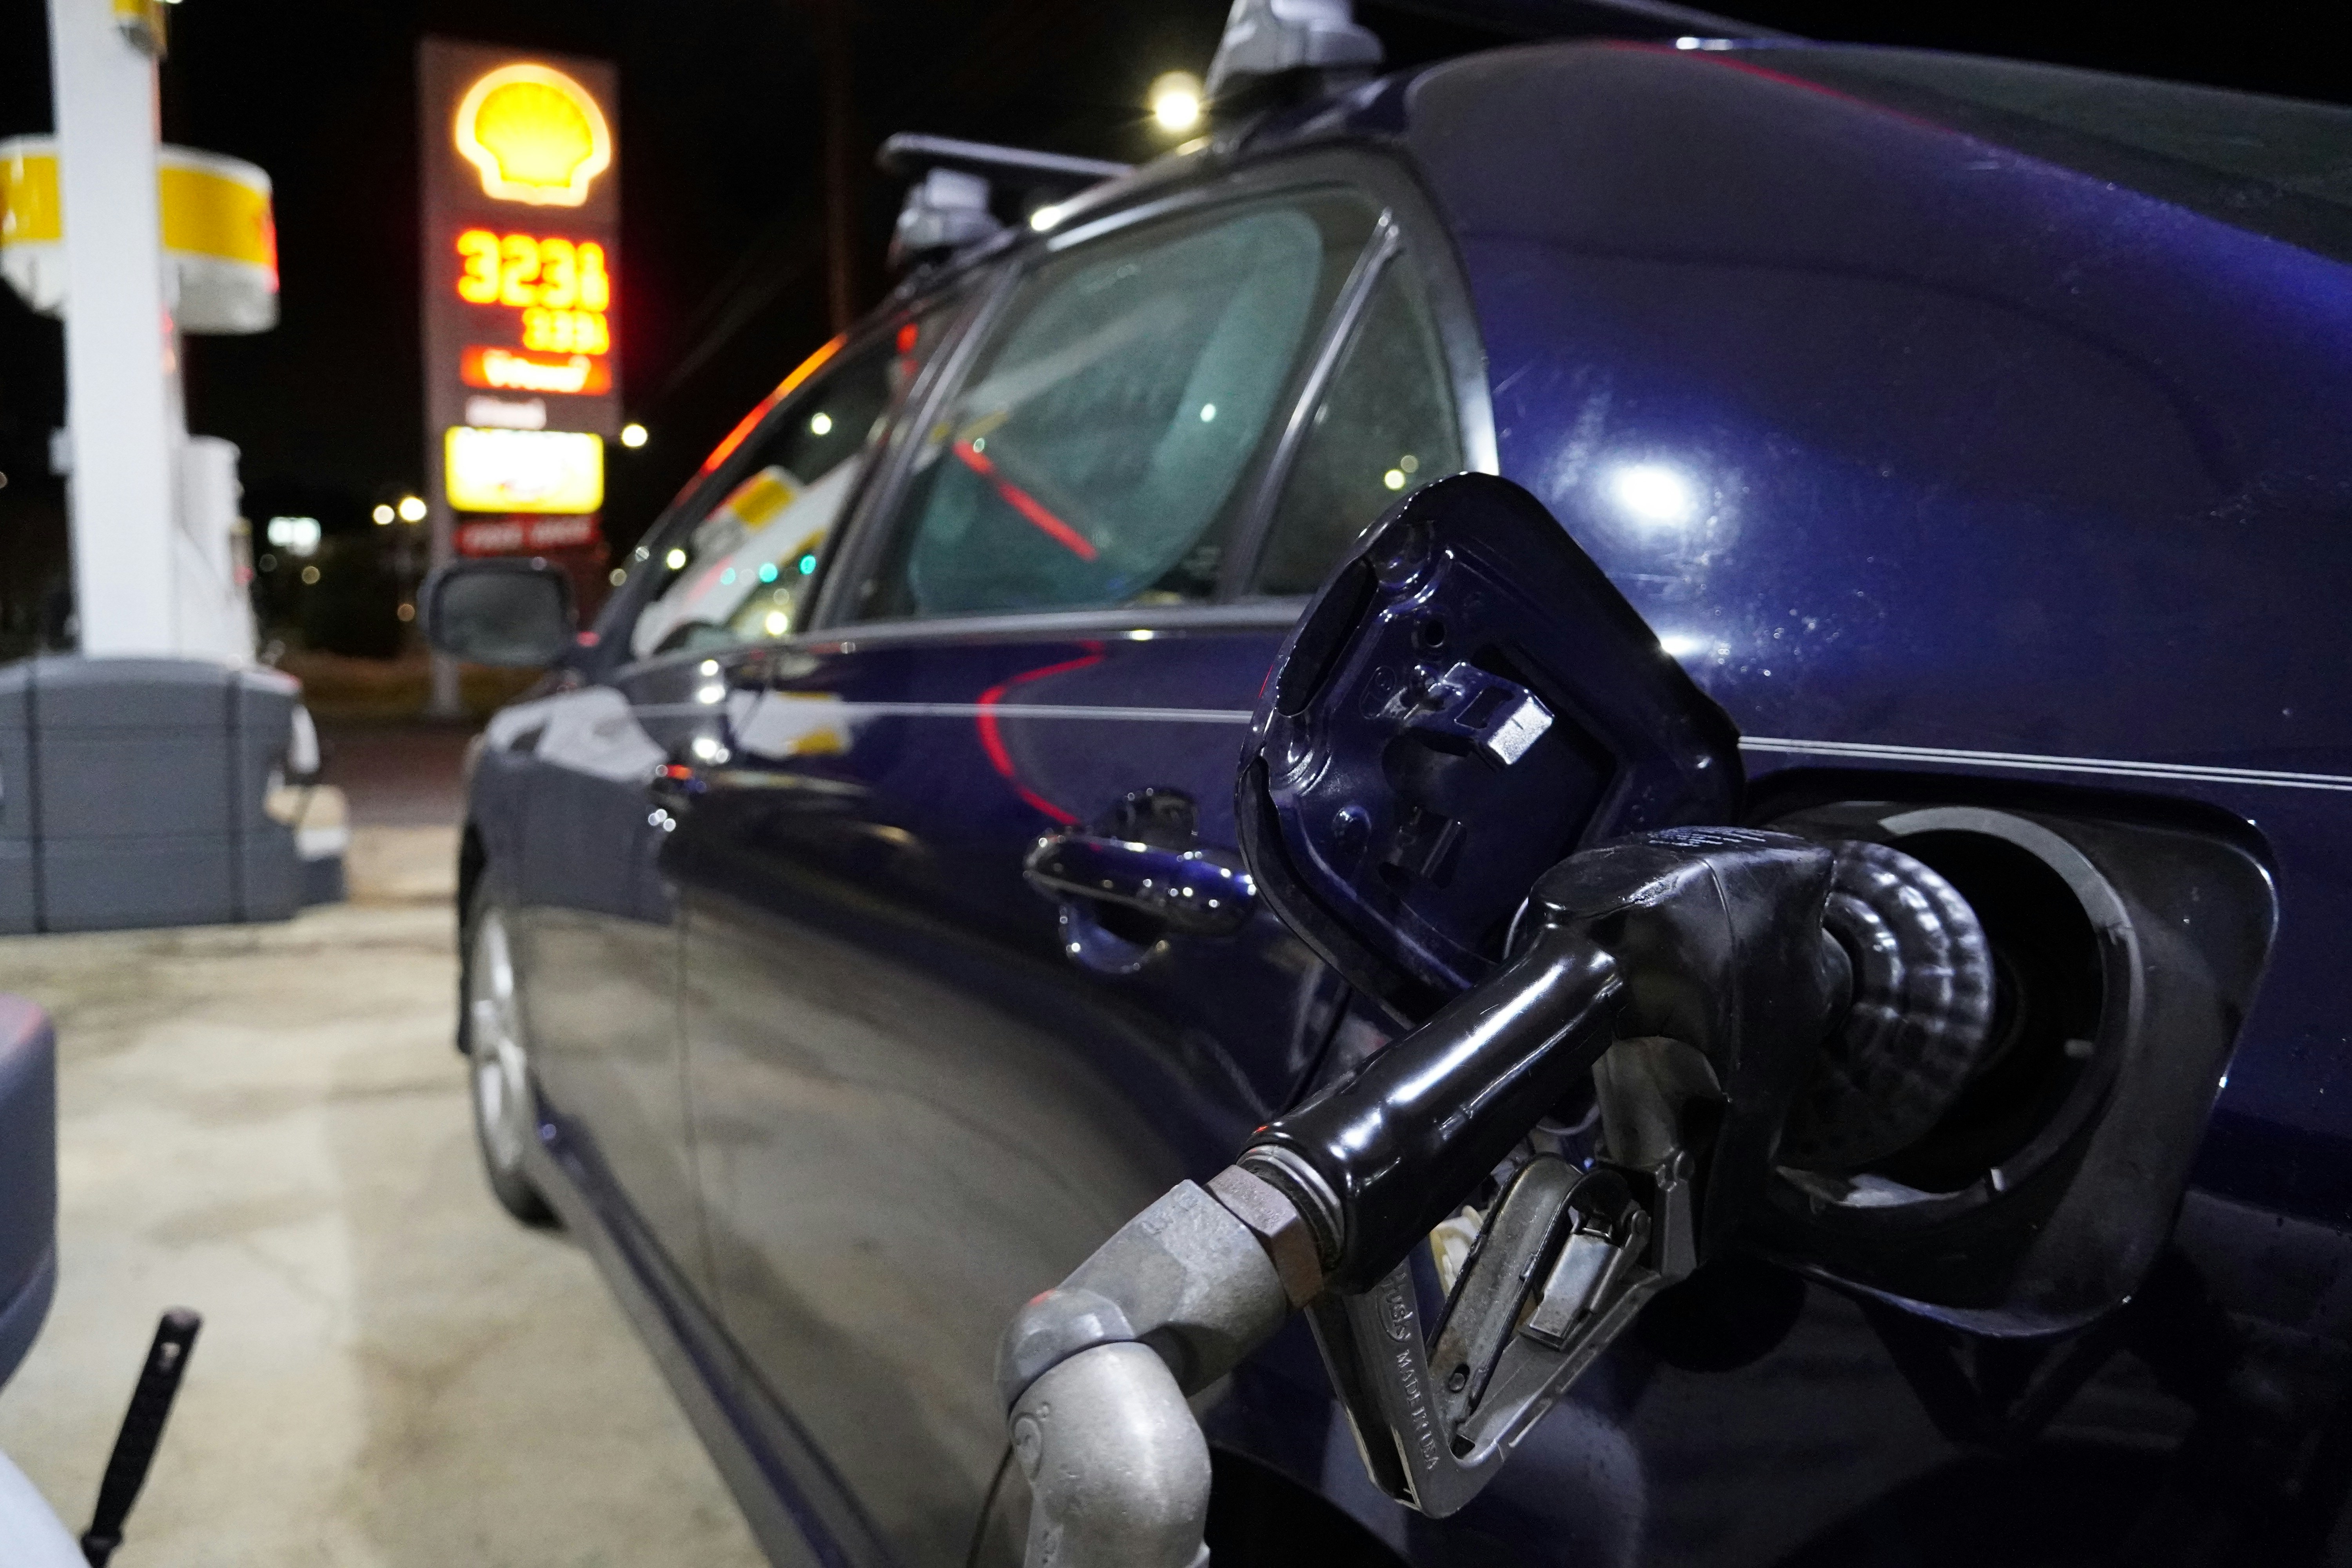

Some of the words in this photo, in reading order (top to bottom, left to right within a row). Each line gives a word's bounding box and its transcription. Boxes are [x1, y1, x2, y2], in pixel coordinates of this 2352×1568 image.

[1396, 1349, 1422, 1406] MADE
[1412, 1406, 1429, 1431] IN
[1420, 1431, 1440, 1471] USA
